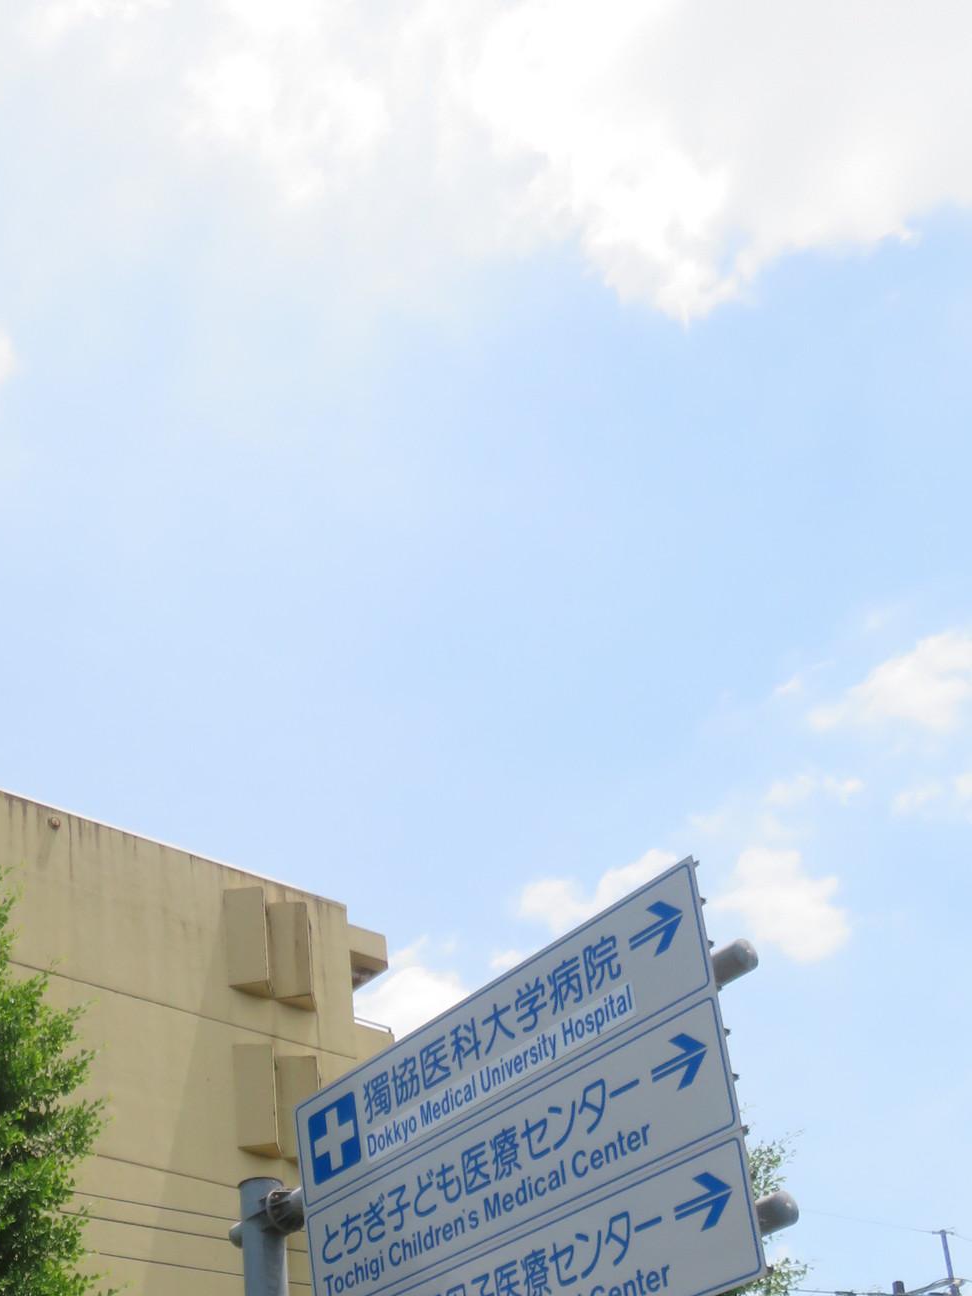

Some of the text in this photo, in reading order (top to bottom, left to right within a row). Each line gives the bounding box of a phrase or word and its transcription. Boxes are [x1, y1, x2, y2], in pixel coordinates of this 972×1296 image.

[363, 935, 622, 1124] 獨協医科大学病院
[367, 984, 633, 1157] Dokkyo Medical University Hospital
[321, 1078, 640, 1265] とちぎ子ども医療センター
[323, 1124, 650, 1296] Tochigi Children's Medical Center
